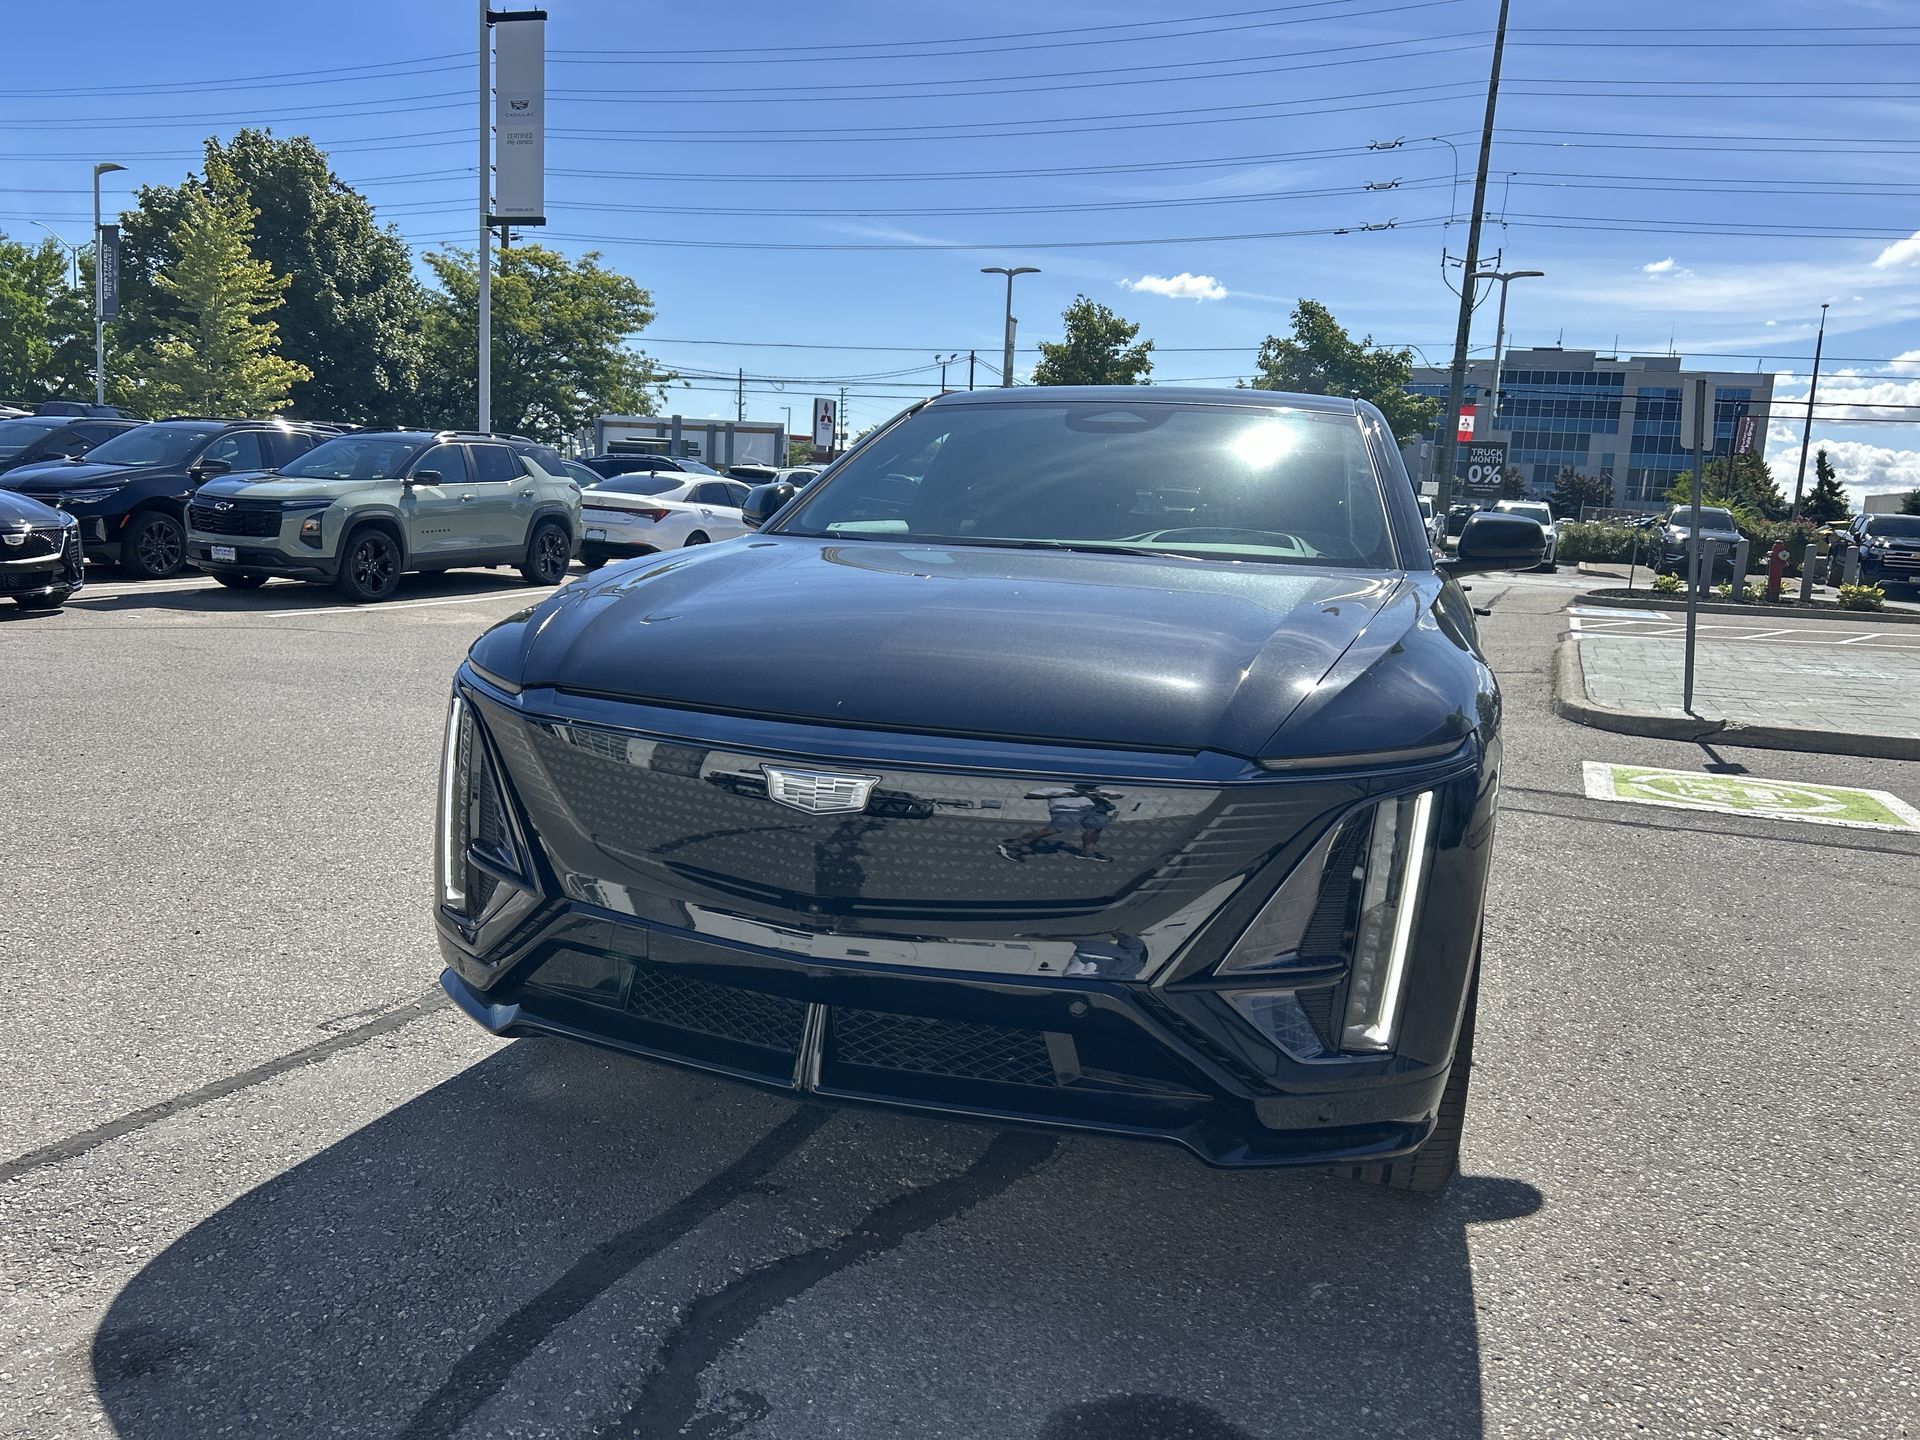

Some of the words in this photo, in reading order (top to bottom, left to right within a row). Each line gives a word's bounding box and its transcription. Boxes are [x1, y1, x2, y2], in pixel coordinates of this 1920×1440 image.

[1471, 448, 1503, 457] TRUCK
[1470, 455, 1503, 464] MONTH
[1468, 464, 1502, 484] 0%
